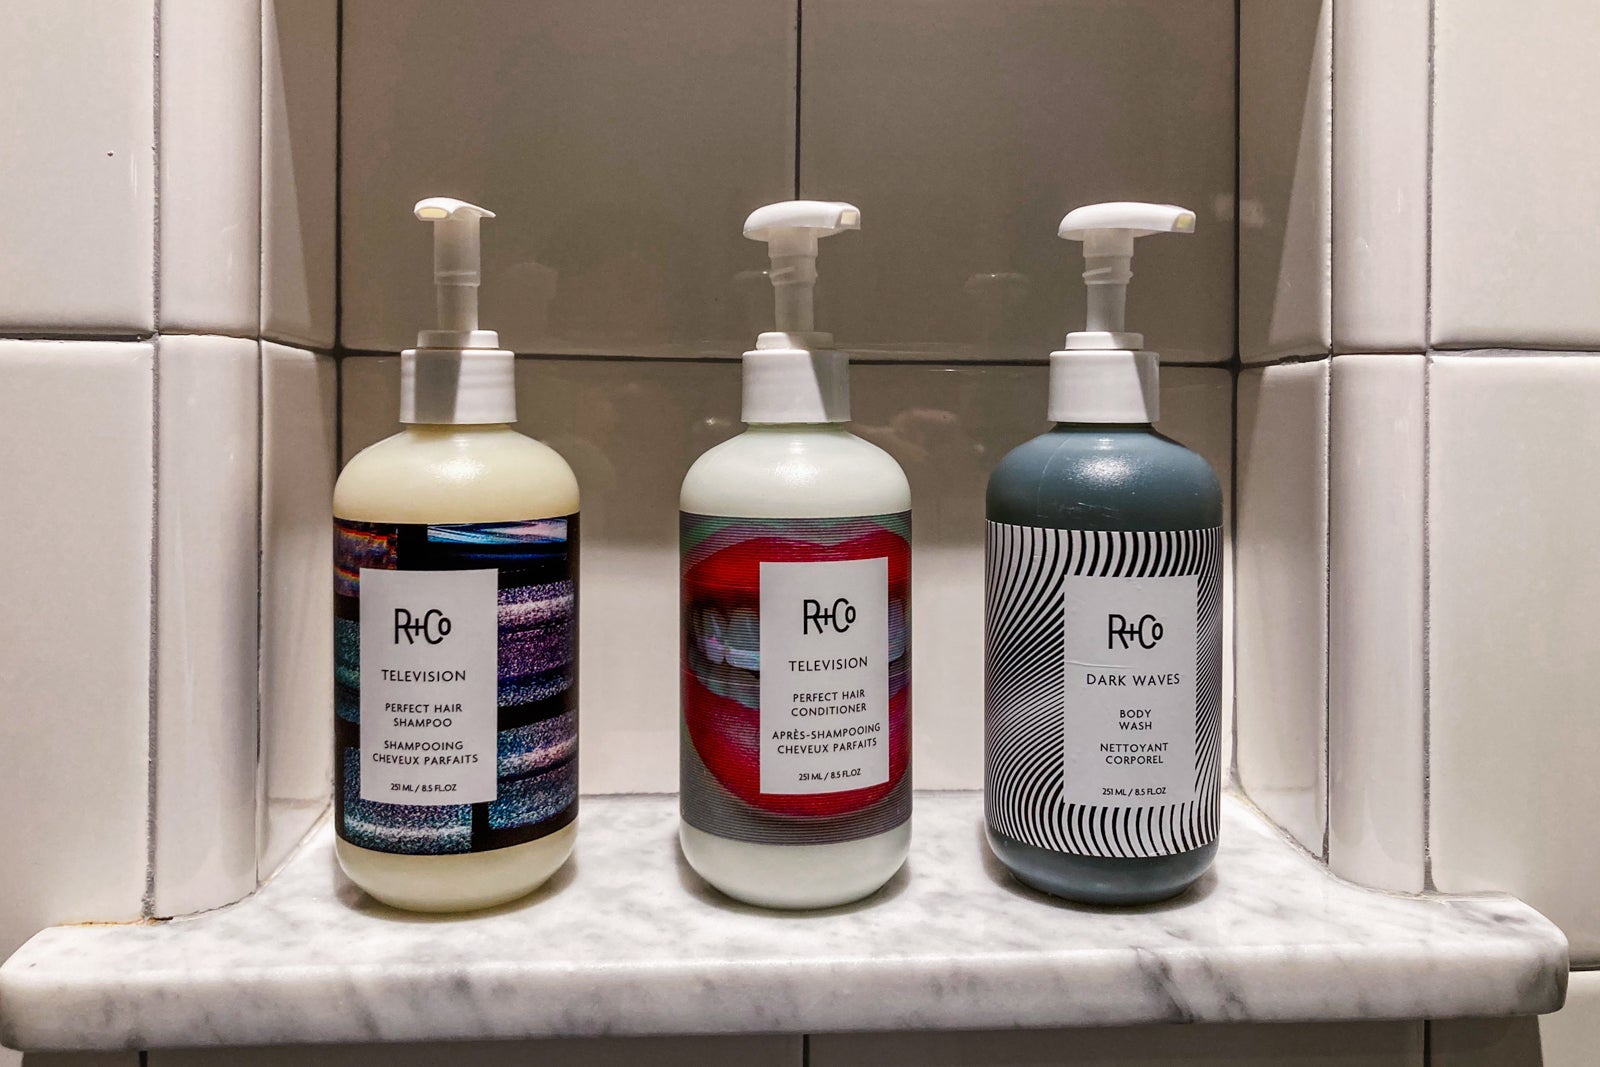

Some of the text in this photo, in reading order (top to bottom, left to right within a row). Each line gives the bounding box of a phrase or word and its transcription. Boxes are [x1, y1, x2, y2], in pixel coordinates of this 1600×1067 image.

[803, 598, 857, 635] R+Co
[394, 608, 452, 645] R+Co
[1108, 614, 1163, 650] R+Co
[788, 656, 868, 672] TELEVISION
[381, 669, 466, 682] TELEVISION
[1086, 673, 1181, 686] DARK WAVES
[792, 689, 866, 703] PERFECT HAIR
[385, 702, 463, 714] PERFECT HAIR
[791, 702, 867, 717] CONDITIONER
[1119, 709, 1152, 718] BODY
[393, 717, 452, 728] SHAMPOO
[1119, 721, 1153, 730] WASH
[772, 722, 881, 740] APRÈS-SHAMPOOING
[384, 740, 464, 751] SHAMPOOING
[777, 737, 877, 754] CHEVEUX PARFAITS
[1100, 742, 1168, 753] NETTOYANT
[372, 753, 479, 765] CHEVEUX PARFAITS
[1105, 755, 1164, 765] CORPOREL
[798, 773, 810, 781] 251
[811, 772, 823, 781] ML
[823, 772, 829, 781] /
[830, 770, 841, 779] 8.5
[390, 783, 401, 791] 251
[402, 784, 414, 793] ML
[414, 784, 420, 793] /
[421, 784, 433, 793] 8.5
[1102, 787, 1114, 796] 251
[1115, 788, 1127, 796] ML
[1127, 788, 1133, 797] /
[1134, 788, 1146, 796] 8.5
